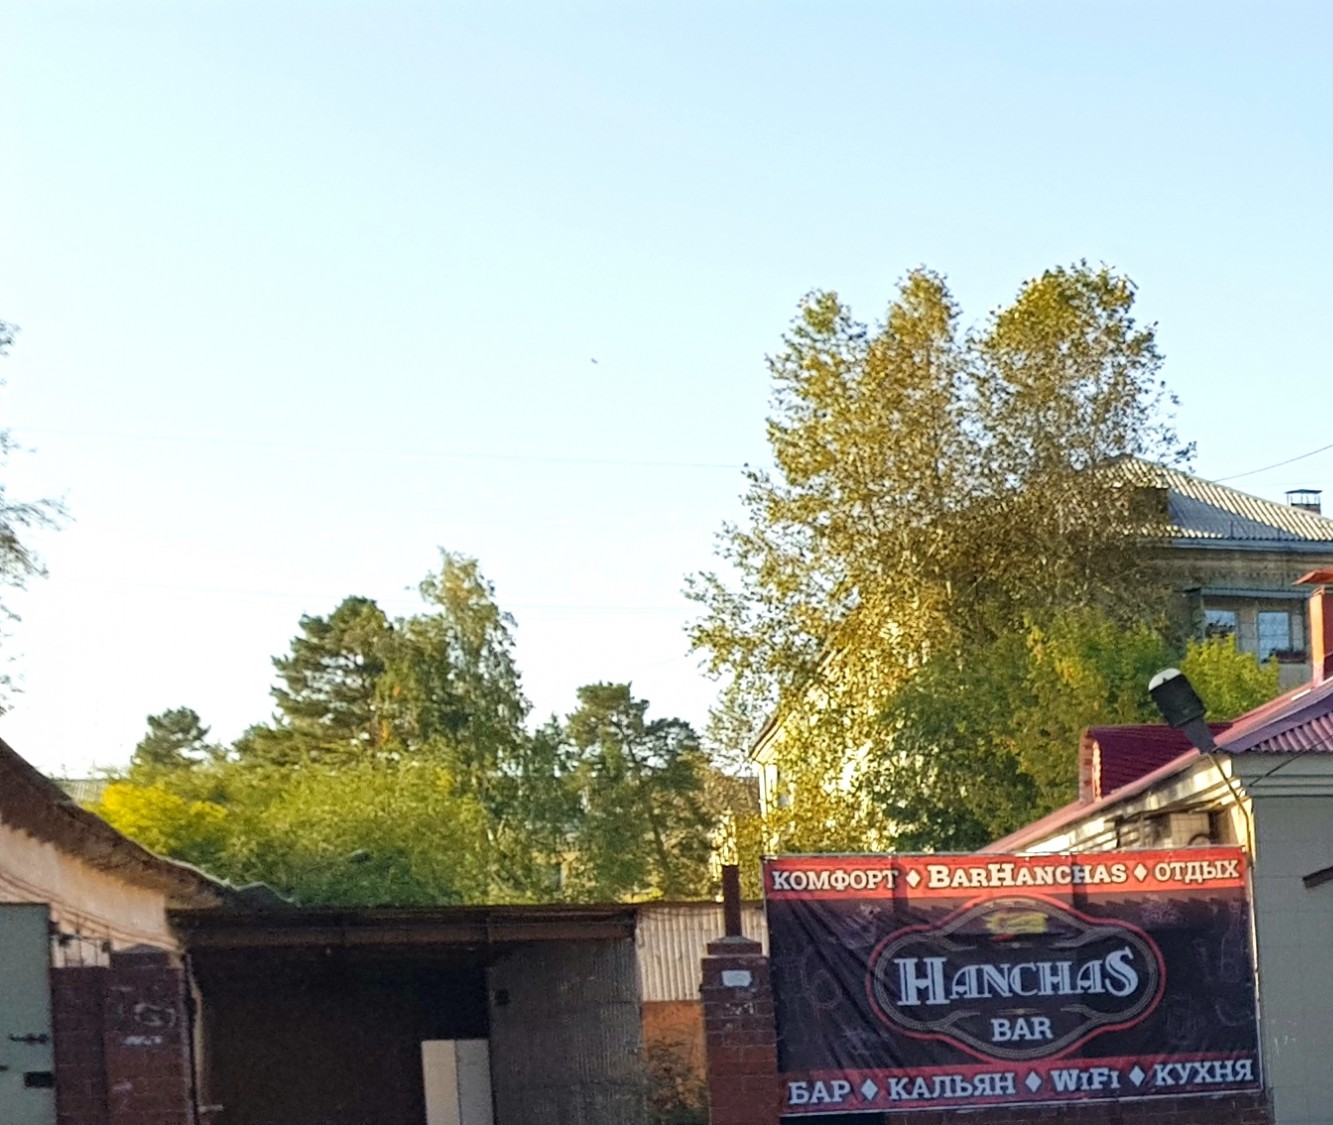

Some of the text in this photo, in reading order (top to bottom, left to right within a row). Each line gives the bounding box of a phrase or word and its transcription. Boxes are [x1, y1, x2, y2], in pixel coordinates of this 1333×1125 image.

[772, 870, 898, 891] КОМФОРТ
[1154, 858, 1240, 882] ОТДЫХ
[894, 947, 1139, 1006] HANCHAS
[788, 1080, 851, 1105] БАР
[888, 1073, 1016, 1101] КАЛЬЯН
[1154, 1058, 1254, 1087] КУХНЯ
